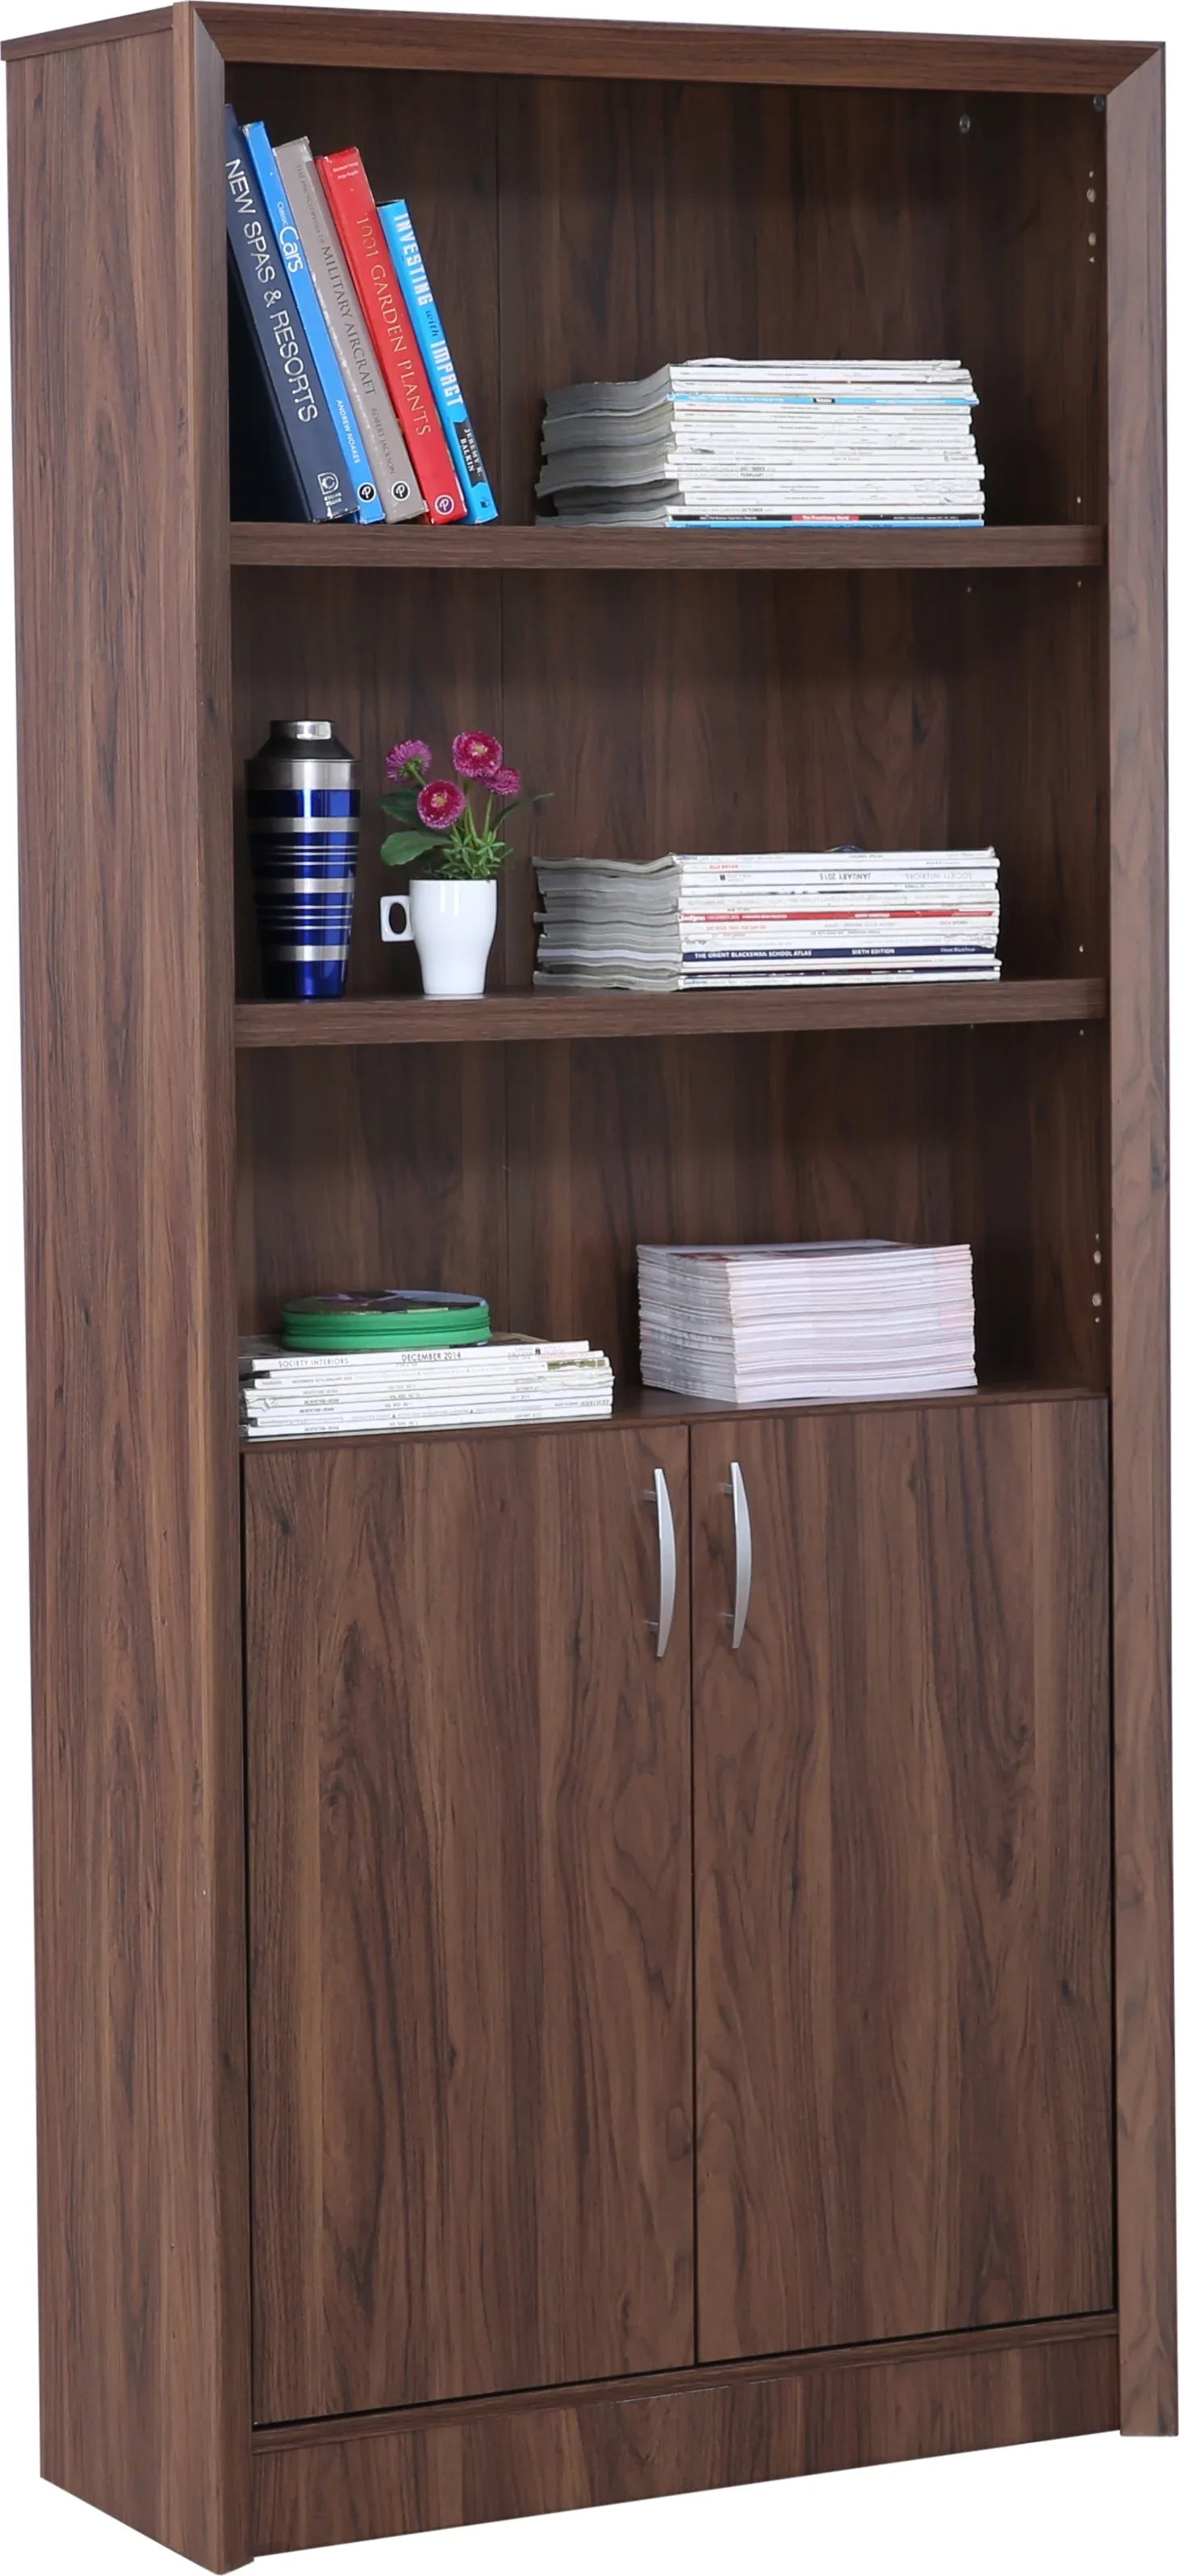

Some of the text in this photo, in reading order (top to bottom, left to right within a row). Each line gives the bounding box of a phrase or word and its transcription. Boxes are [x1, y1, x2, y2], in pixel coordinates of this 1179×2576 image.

[279, 227, 303, 273] Cars
[226, 159, 318, 422] NEW SPAS & RESORTS
[394, 213, 464, 407] INVESTING with IMPACT
[321, 246, 353, 318] MILITARY
[345, 323, 377, 395] AIRCRAFT
[357, 217, 432, 436] 1001 GARDEN PLANTS
[336, 399, 362, 464] ANDREW NOAKES
[371, 407, 396, 474] ROBERT JACKSON
[460, 438, 475, 473] BALKIN
[463, 428, 481, 465] JEREMY
[838, 872, 871, 880] JANUARY
[278, 1357, 349, 1368] SOCIETY INTERIORS
[401, 1351, 462, 1363] DECEMBER 2014
